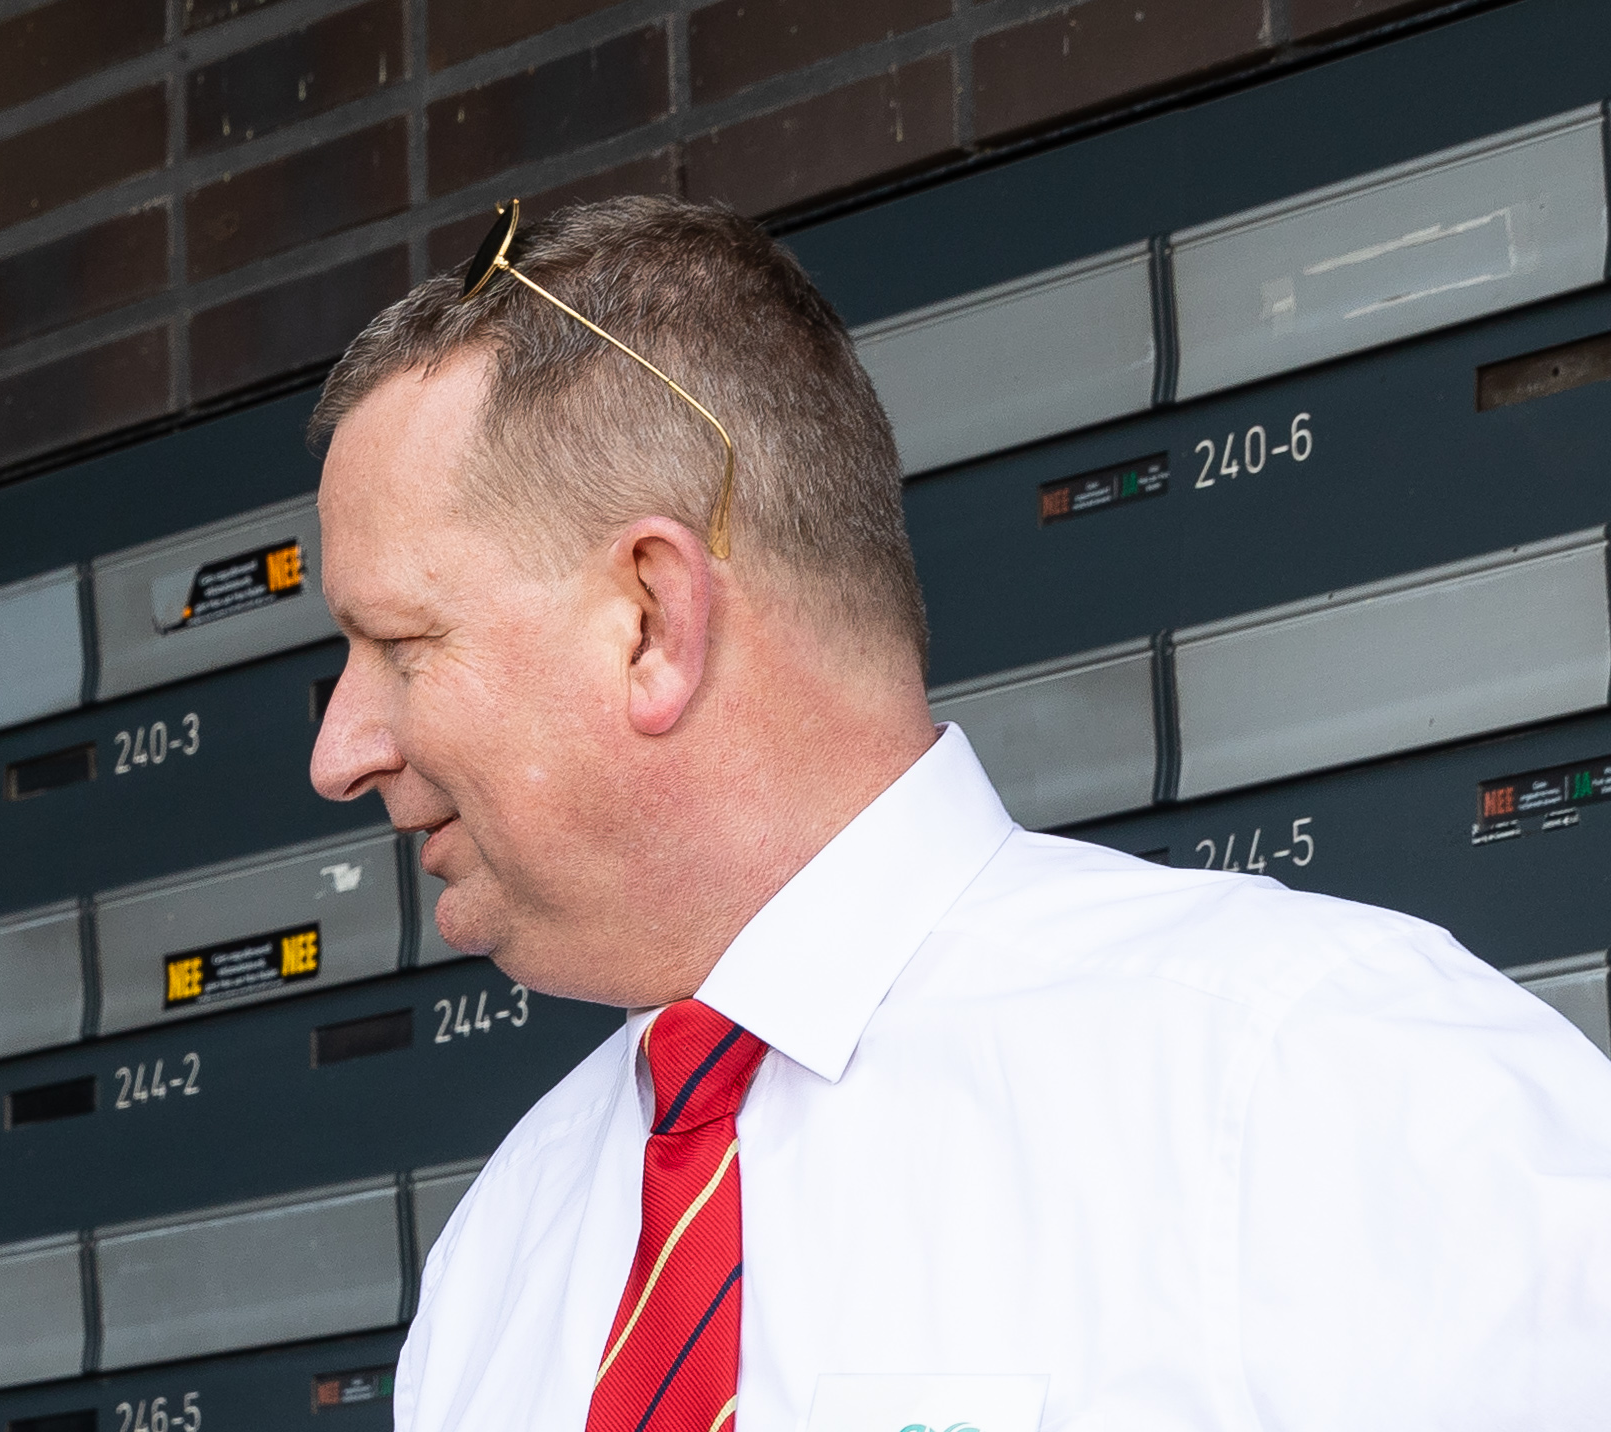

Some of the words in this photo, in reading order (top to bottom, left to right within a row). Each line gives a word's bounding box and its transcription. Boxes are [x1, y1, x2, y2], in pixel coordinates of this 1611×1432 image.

[1194, 412, 1313, 489] 240-6
[114, 712, 200, 775] 240-3
[434, 983, 529, 1044] 244-3
[115, 1052, 201, 1110] 244-2
